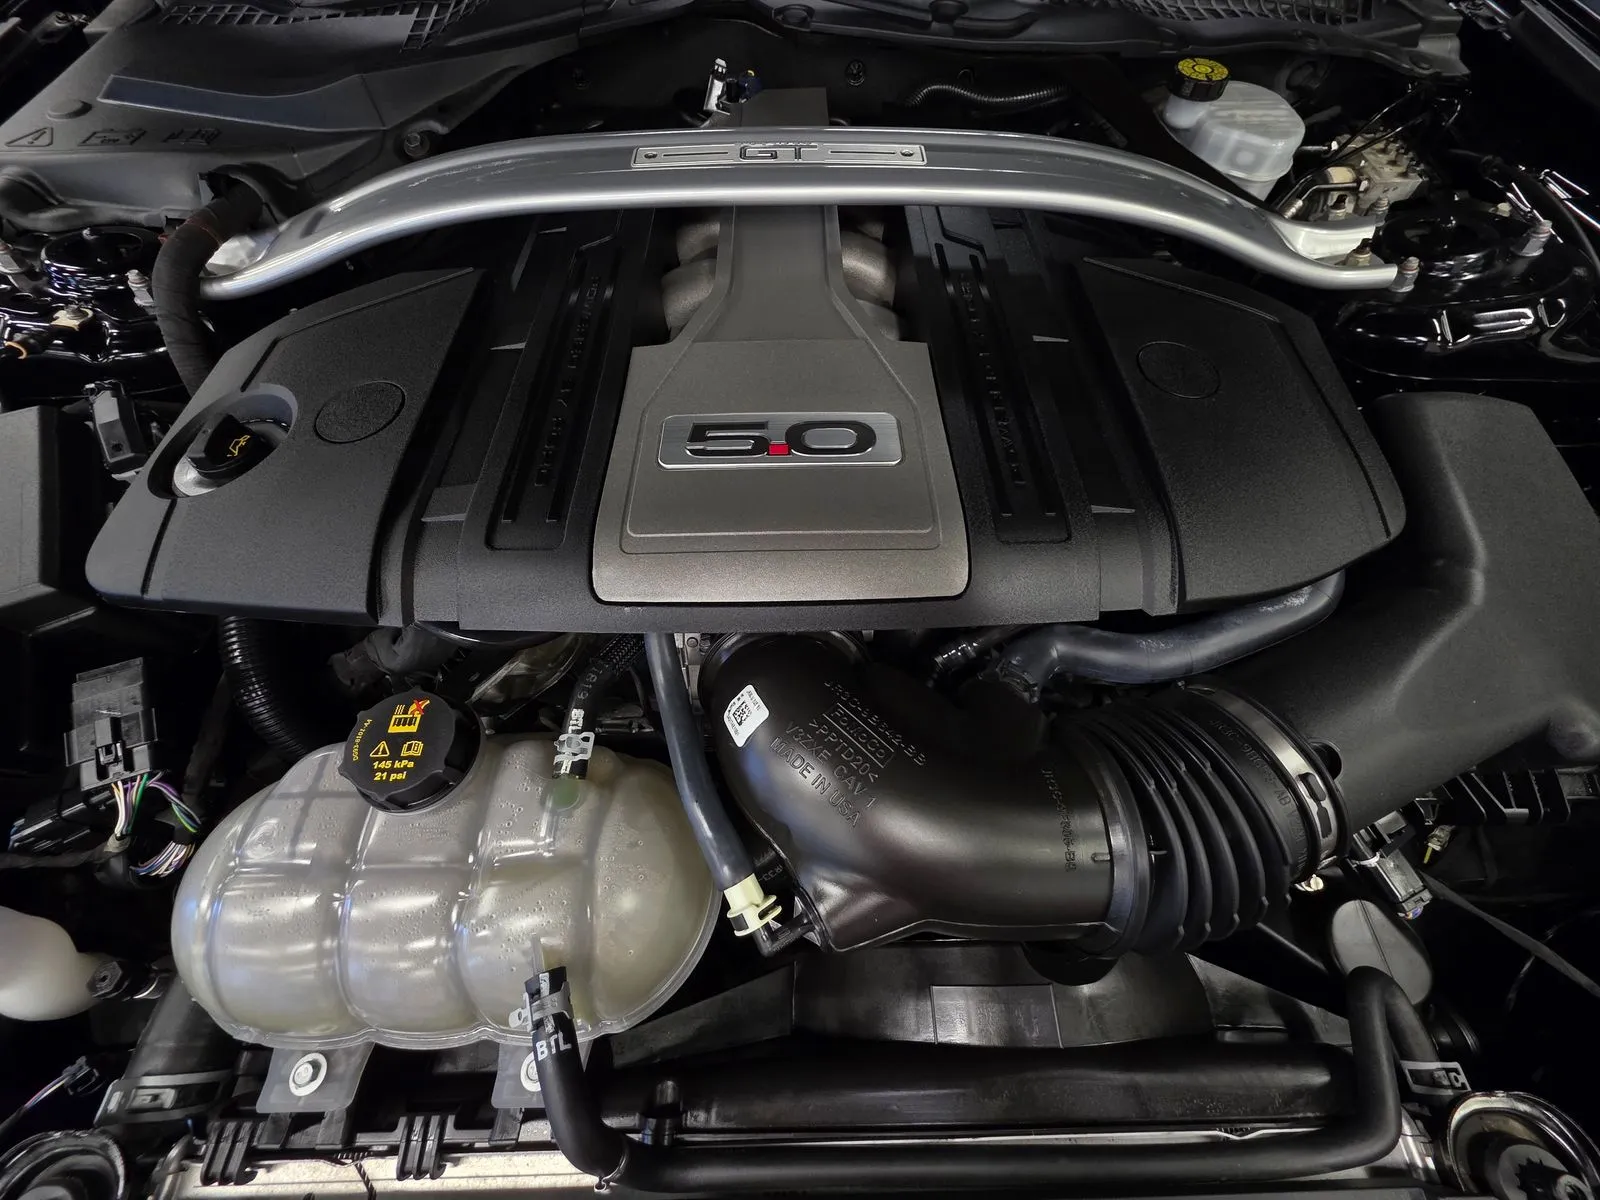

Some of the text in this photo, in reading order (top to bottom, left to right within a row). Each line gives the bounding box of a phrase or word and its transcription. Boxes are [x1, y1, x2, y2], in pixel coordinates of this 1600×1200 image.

[740, 144, 818, 161] GT
[685, 420, 878, 458] 5.0
[372, 760, 415, 769] 145 kPa
[373, 771, 407, 782] 21 psi
[832, 762, 866, 796] CAV
[768, 735, 863, 827] MADE IN USA
[535, 1031, 572, 1061] BTL
